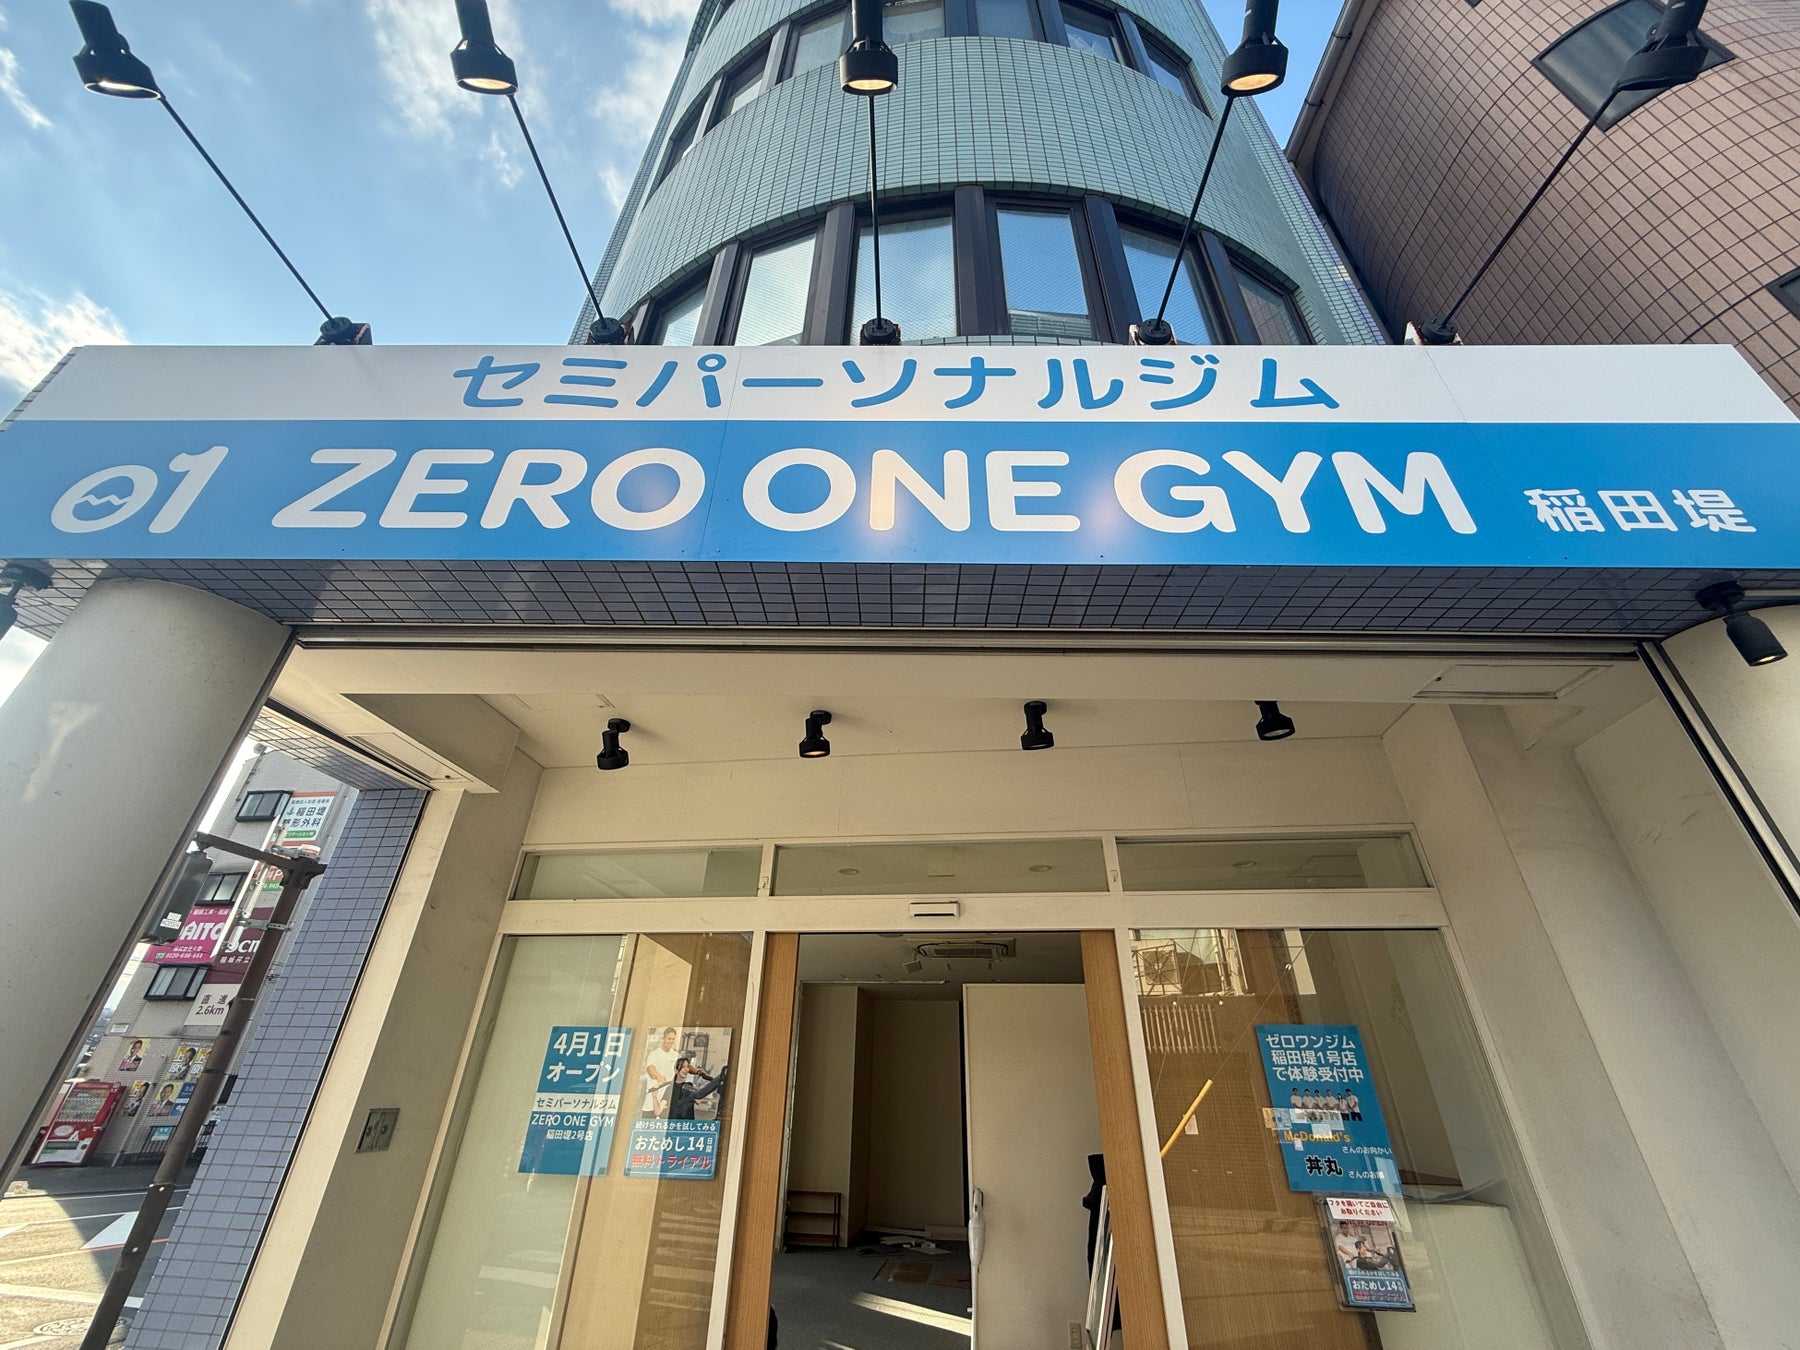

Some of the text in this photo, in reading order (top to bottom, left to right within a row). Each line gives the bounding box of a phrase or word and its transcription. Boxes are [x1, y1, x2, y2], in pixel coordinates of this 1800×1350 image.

[453, 353, 1340, 410] セミパーソナルジム
[271, 448, 706, 532] ZERO
[743, 448, 1081, 533] ONE
[1113, 449, 1477, 535] GYM
[1524, 488, 1758, 533] 稲田堤
[196, 1005, 224, 1016] 2.6km
[553, 1031, 626, 1058] 4月1日
[1266, 1034, 1356, 1049] ゼロワンジム
[1271, 1050, 1357, 1066] 稲田堤1号店
[546, 1061, 621, 1083] オープン
[1272, 1066, 1364, 1083] で体験受付中
[531, 1114, 614, 1127] ZERO ONE GYM
[1304, 1155, 1343, 1177] 丼丸
